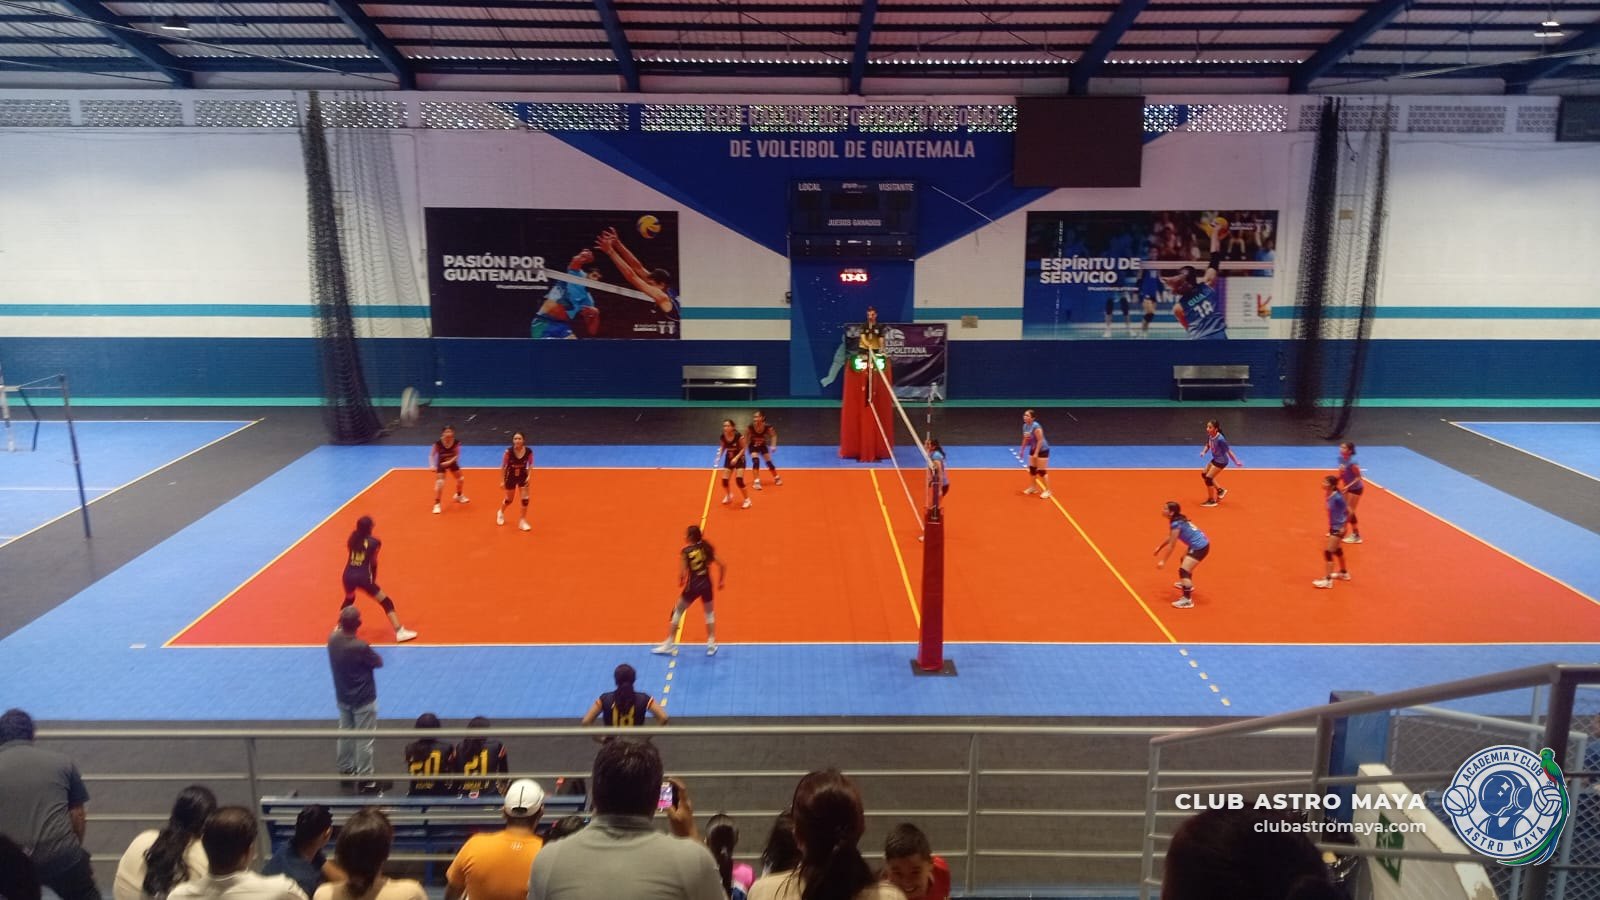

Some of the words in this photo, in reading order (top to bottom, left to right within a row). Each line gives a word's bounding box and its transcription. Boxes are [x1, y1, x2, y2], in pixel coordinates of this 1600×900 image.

[729, 139, 752, 159] DE
[756, 139, 839, 159] VOLEIBOL
[844, 139, 867, 159] DE
[871, 139, 976, 159] GUATEMALA
[798, 183, 822, 192] LOCAL
[878, 183, 914, 192] VISITANTE
[442, 252, 507, 268] PASIÓN
[509, 255, 545, 269] POR
[1040, 255, 1115, 270] ESPÍRITU
[1118, 257, 1140, 270] DE
[443, 268, 549, 282] GUATEMALA
[1040, 271, 1118, 284] SERVICIO
